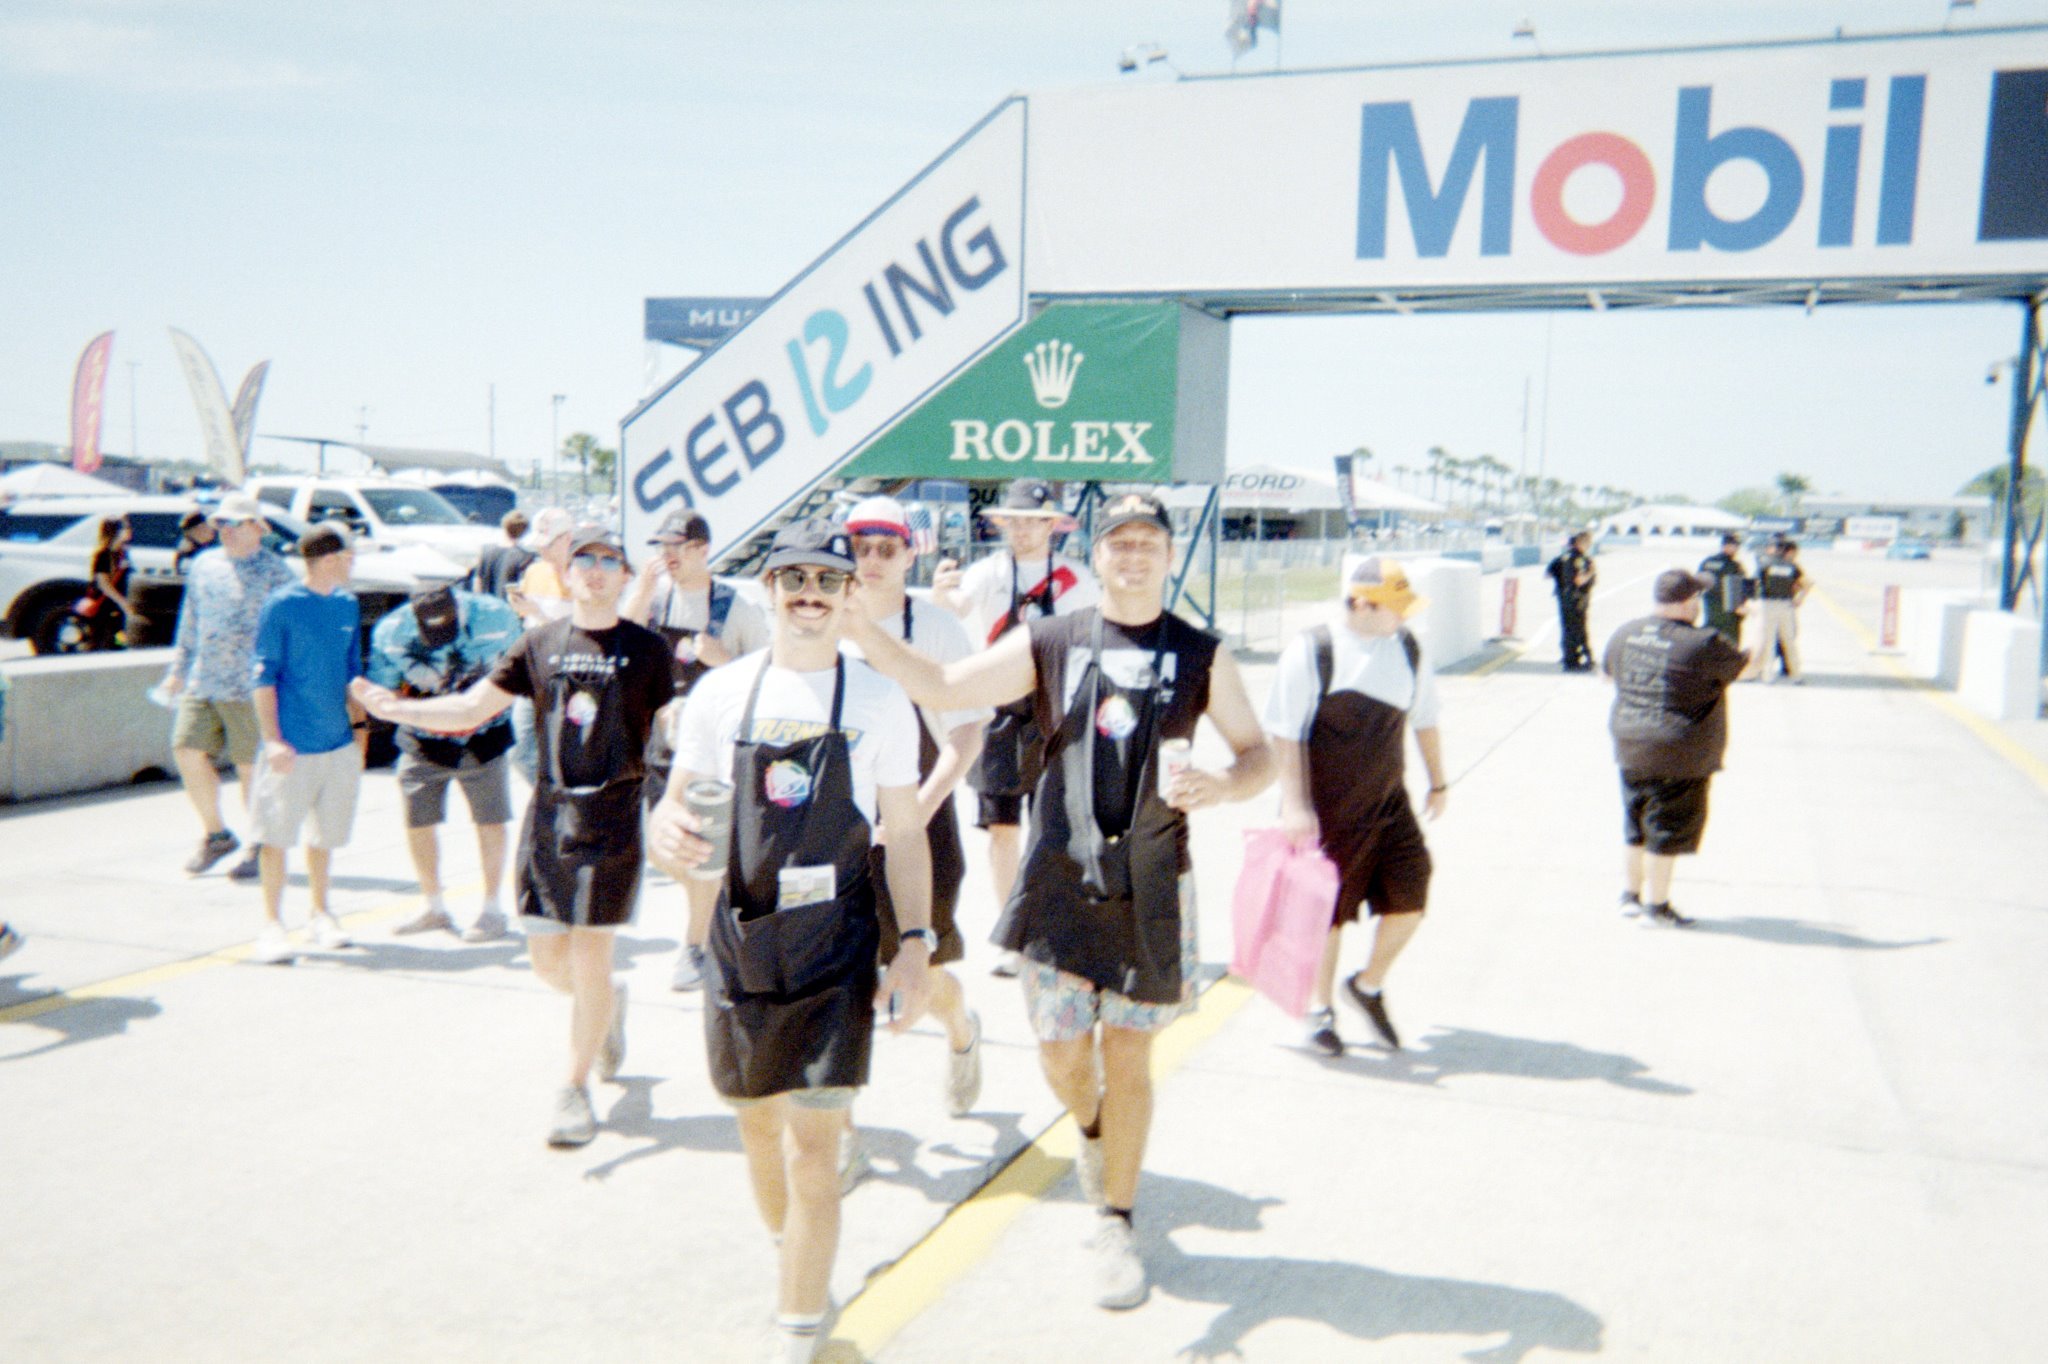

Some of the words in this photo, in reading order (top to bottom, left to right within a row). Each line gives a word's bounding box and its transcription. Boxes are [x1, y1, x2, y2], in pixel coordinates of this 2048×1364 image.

[1355, 74, 1928, 261] Mobil
[950, 419, 1154, 464] ROLEX
[1226, 473, 1298, 490] FORD
